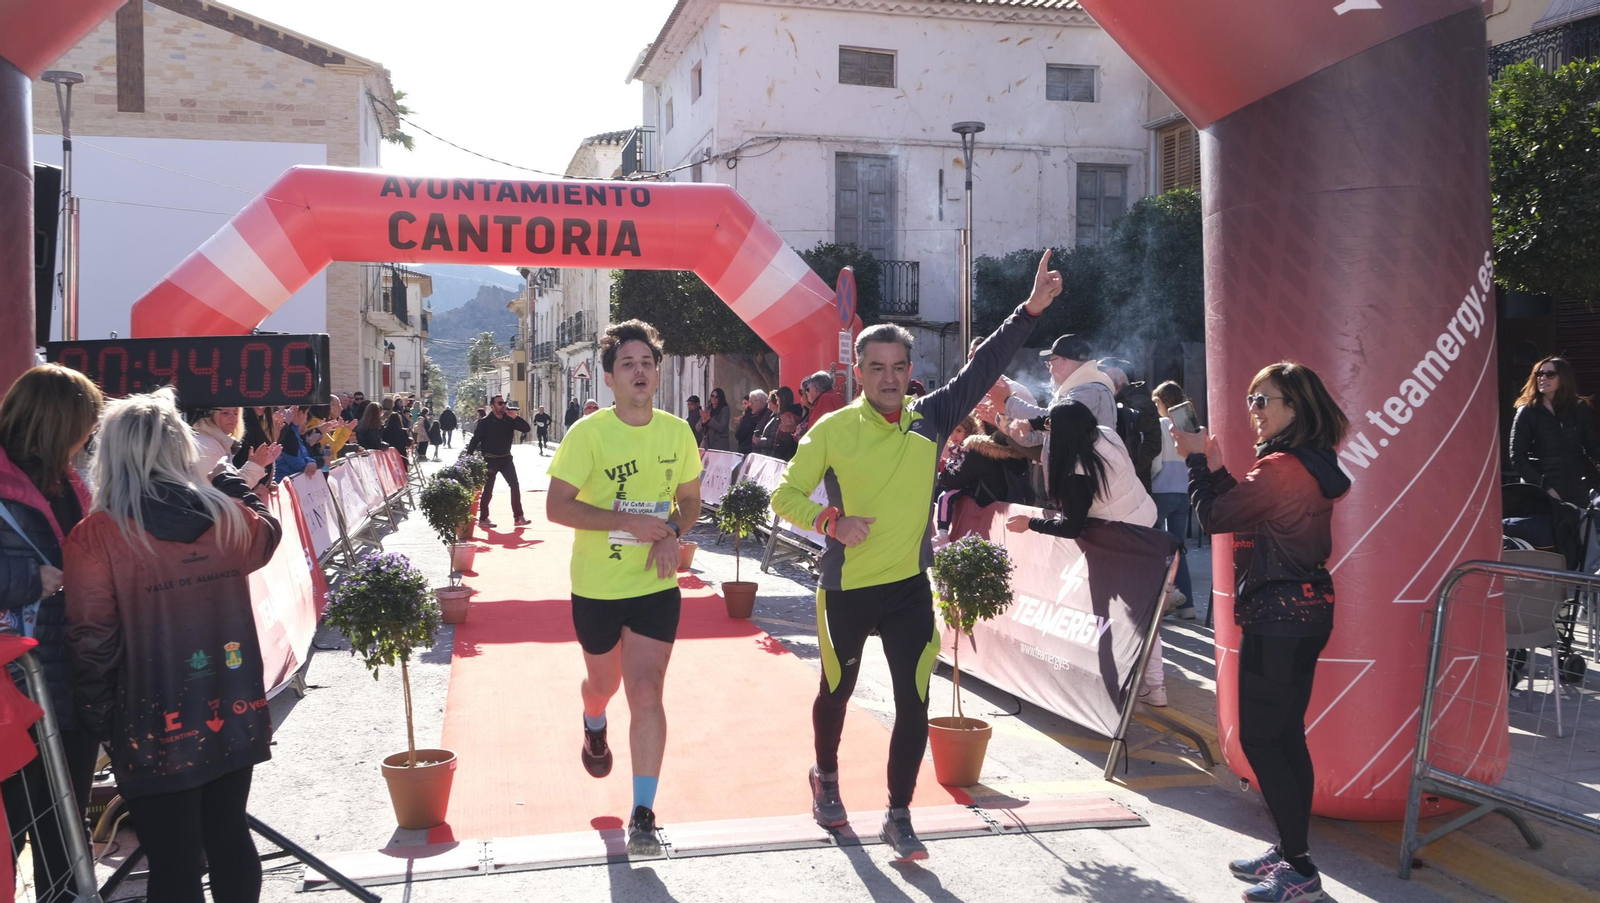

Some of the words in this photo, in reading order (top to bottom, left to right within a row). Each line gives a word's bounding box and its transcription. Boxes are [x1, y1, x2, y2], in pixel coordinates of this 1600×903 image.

[380, 176, 651, 207] AYUNTAMIENTO
[388, 211, 642, 257] CANTORIA
[145, 581, 175, 594] VALLE
[179, 577, 193, 588] DE
[1011, 594, 1114, 647] TEAMERGY
